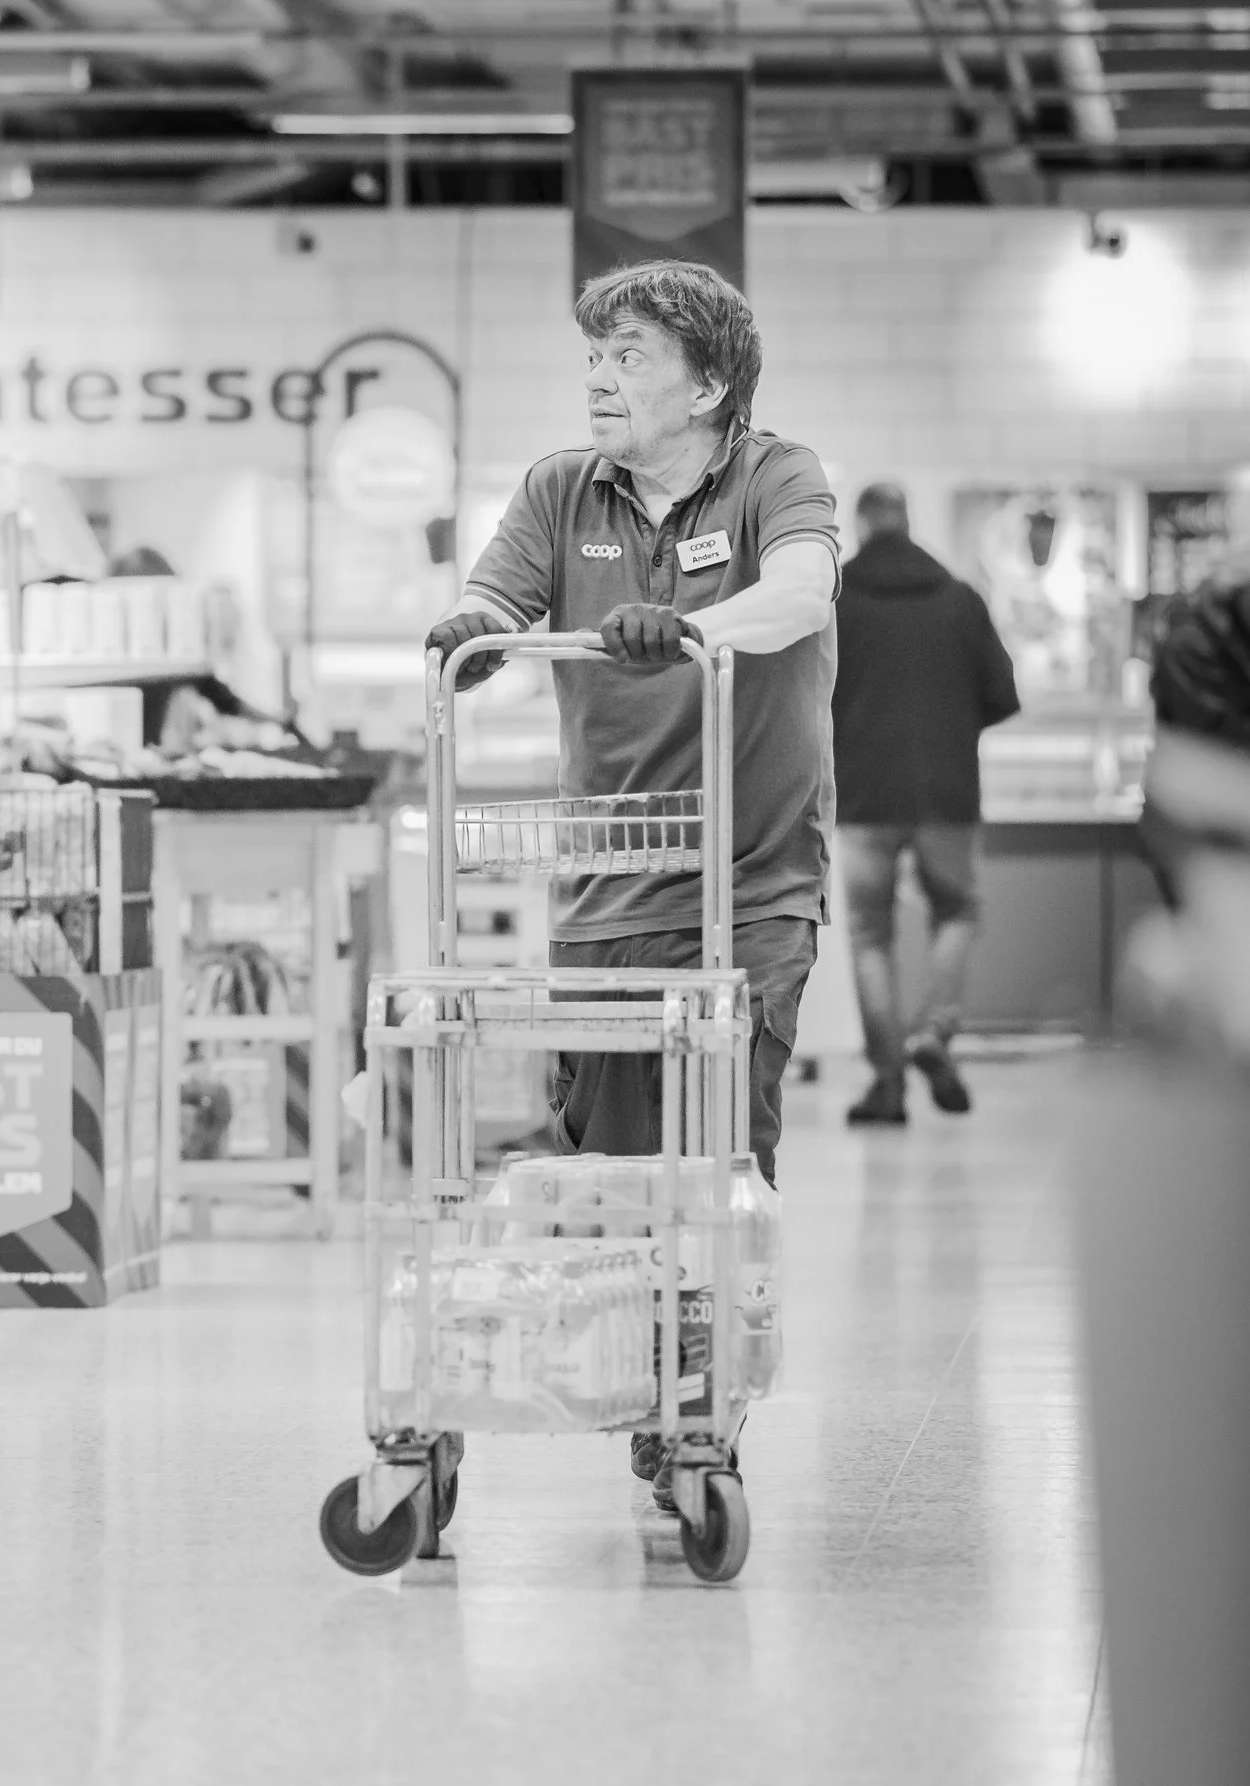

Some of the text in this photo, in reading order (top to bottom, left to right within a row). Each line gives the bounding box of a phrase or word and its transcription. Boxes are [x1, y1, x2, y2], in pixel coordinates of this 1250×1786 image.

[690, 540, 716, 551] coop
[582, 544, 622, 560] coop
[692, 551, 720, 563] Anders
